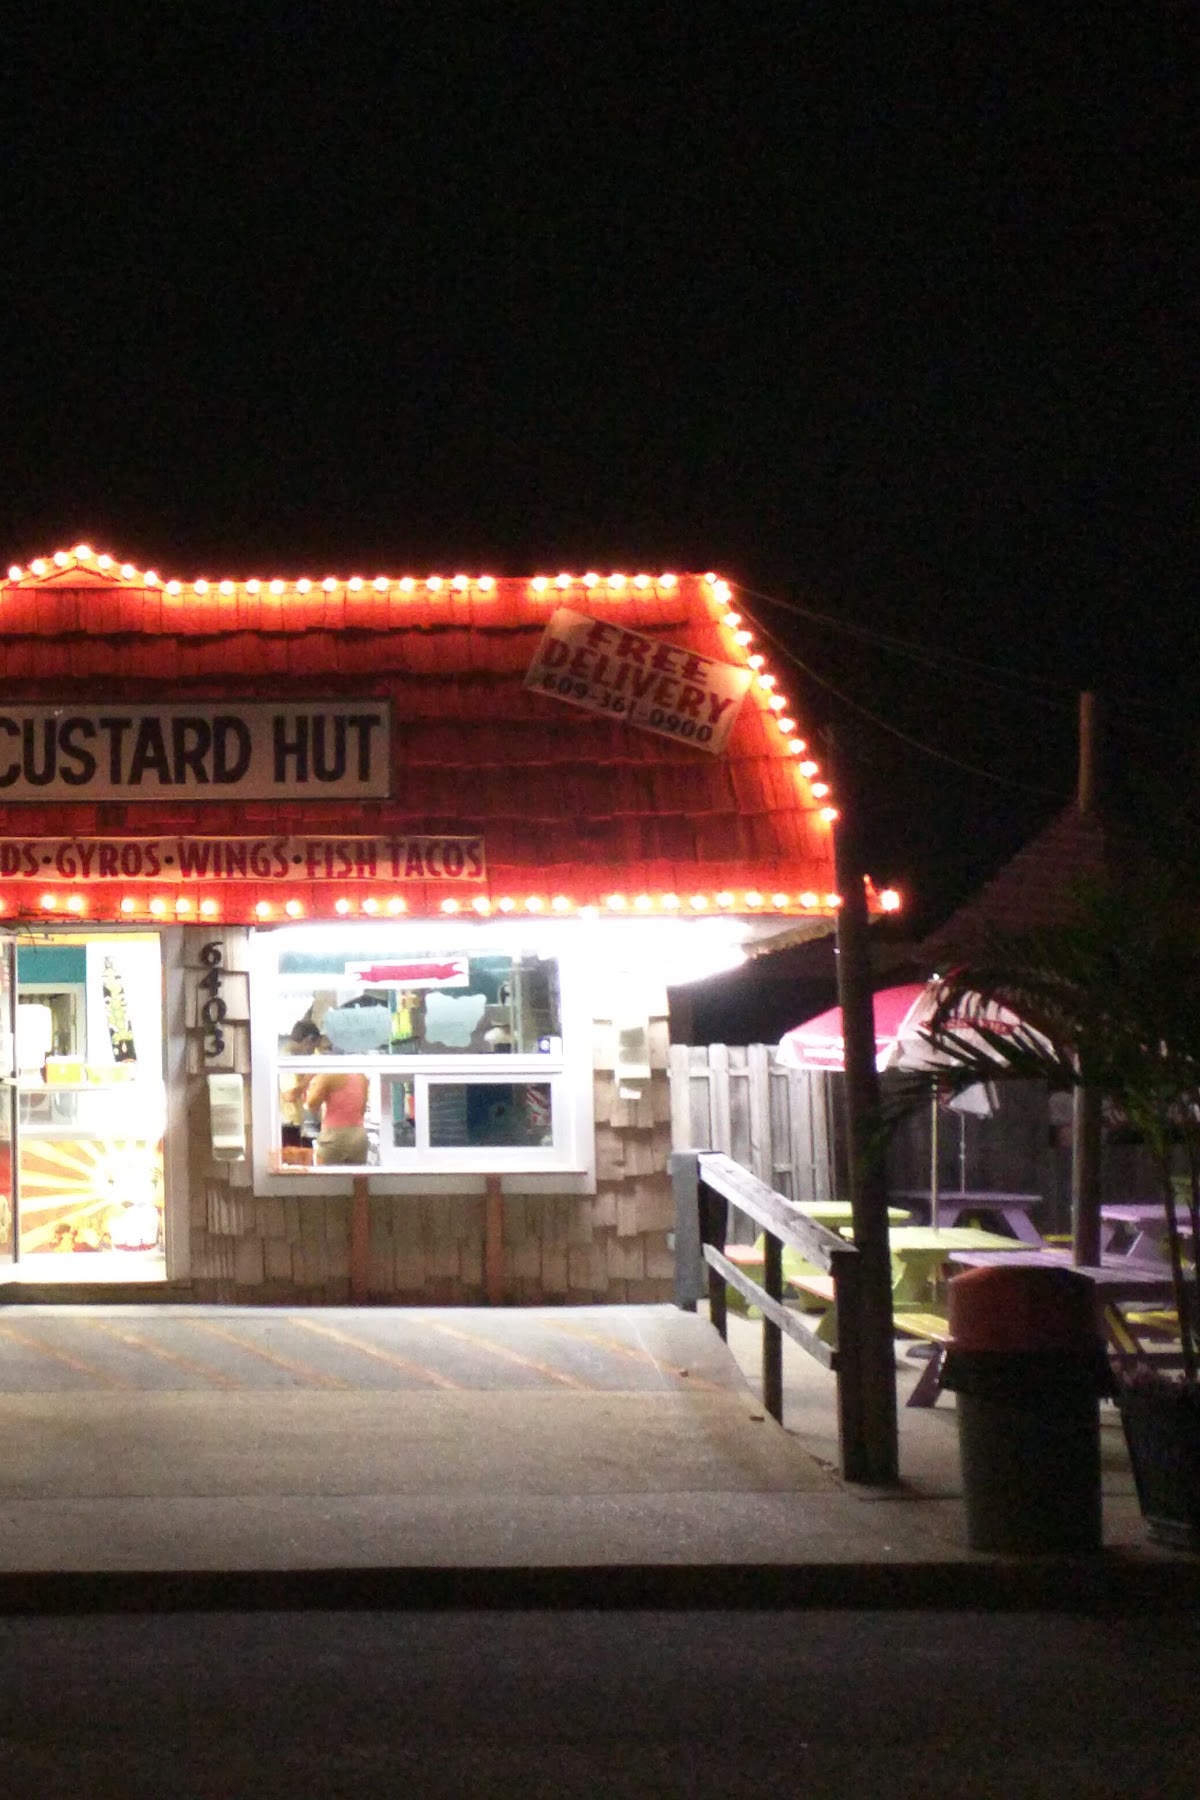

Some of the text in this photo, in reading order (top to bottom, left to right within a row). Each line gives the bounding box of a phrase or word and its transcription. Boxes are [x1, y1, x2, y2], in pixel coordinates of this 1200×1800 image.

[543, 637, 733, 724] DELIVERY
[586, 620, 715, 686] FREE
[274, 714, 381, 783] HUT
[56, 841, 161, 879] GYROS
[177, 840, 290, 879] WINGS
[305, 840, 377, 880] FISH
[385, 840, 483, 878] TACOS
[200, 941, 228, 1058] 6403
